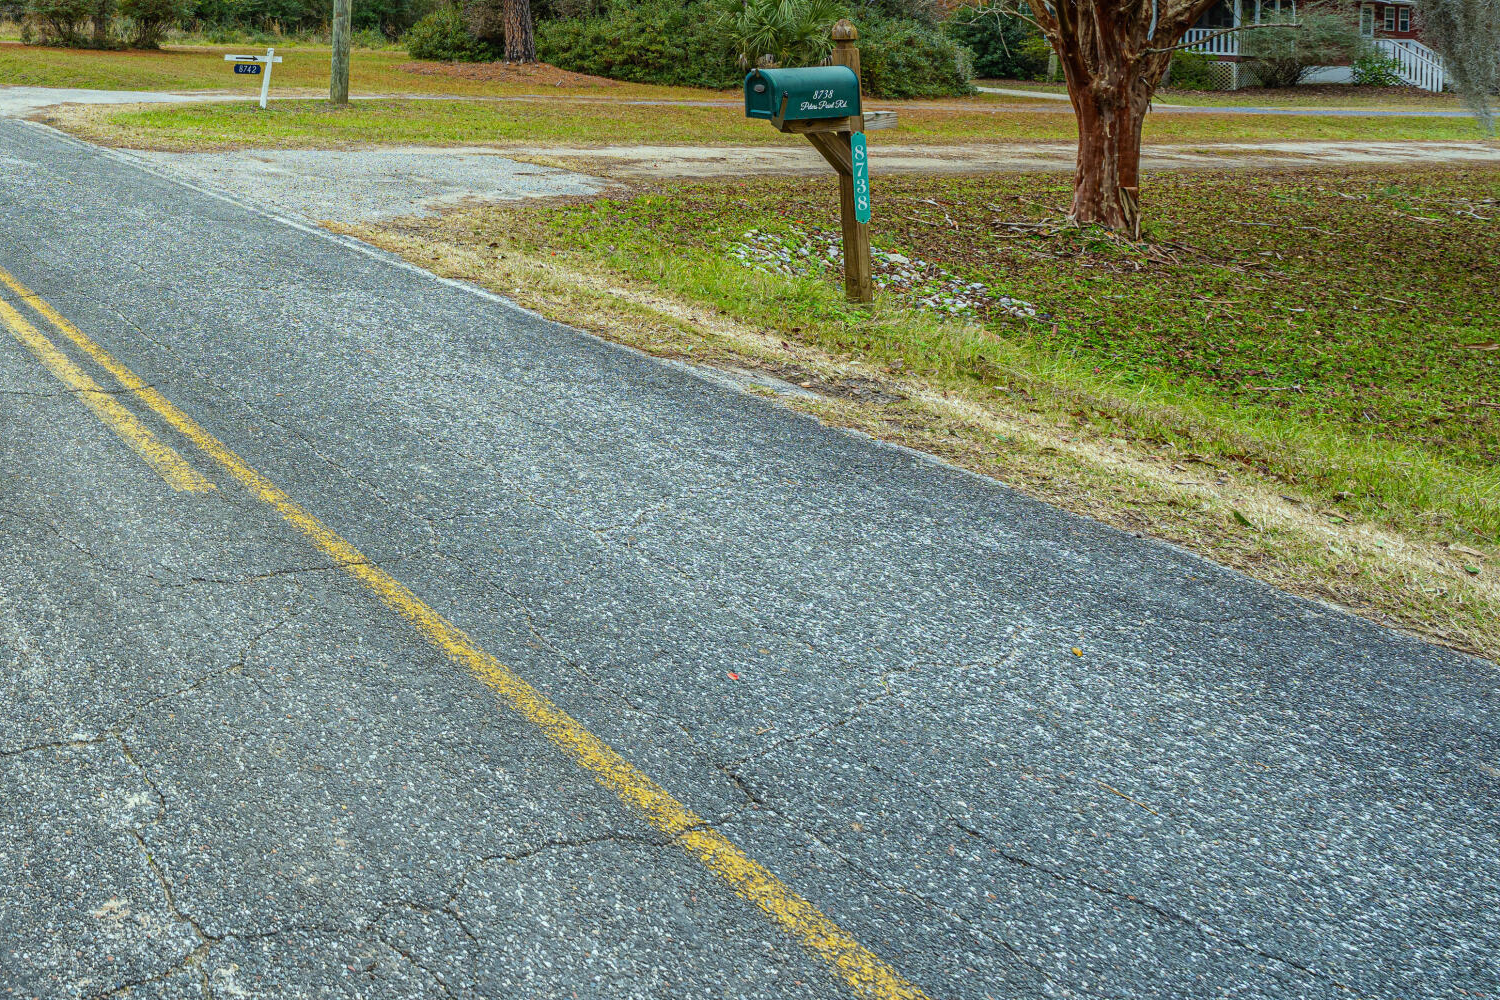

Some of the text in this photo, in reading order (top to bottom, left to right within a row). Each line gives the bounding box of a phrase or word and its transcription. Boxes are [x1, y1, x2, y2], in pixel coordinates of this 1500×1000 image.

[238, 65, 257, 74] 8742
[812, 89, 834, 100] 8738
[854, 144, 869, 211] 8738
